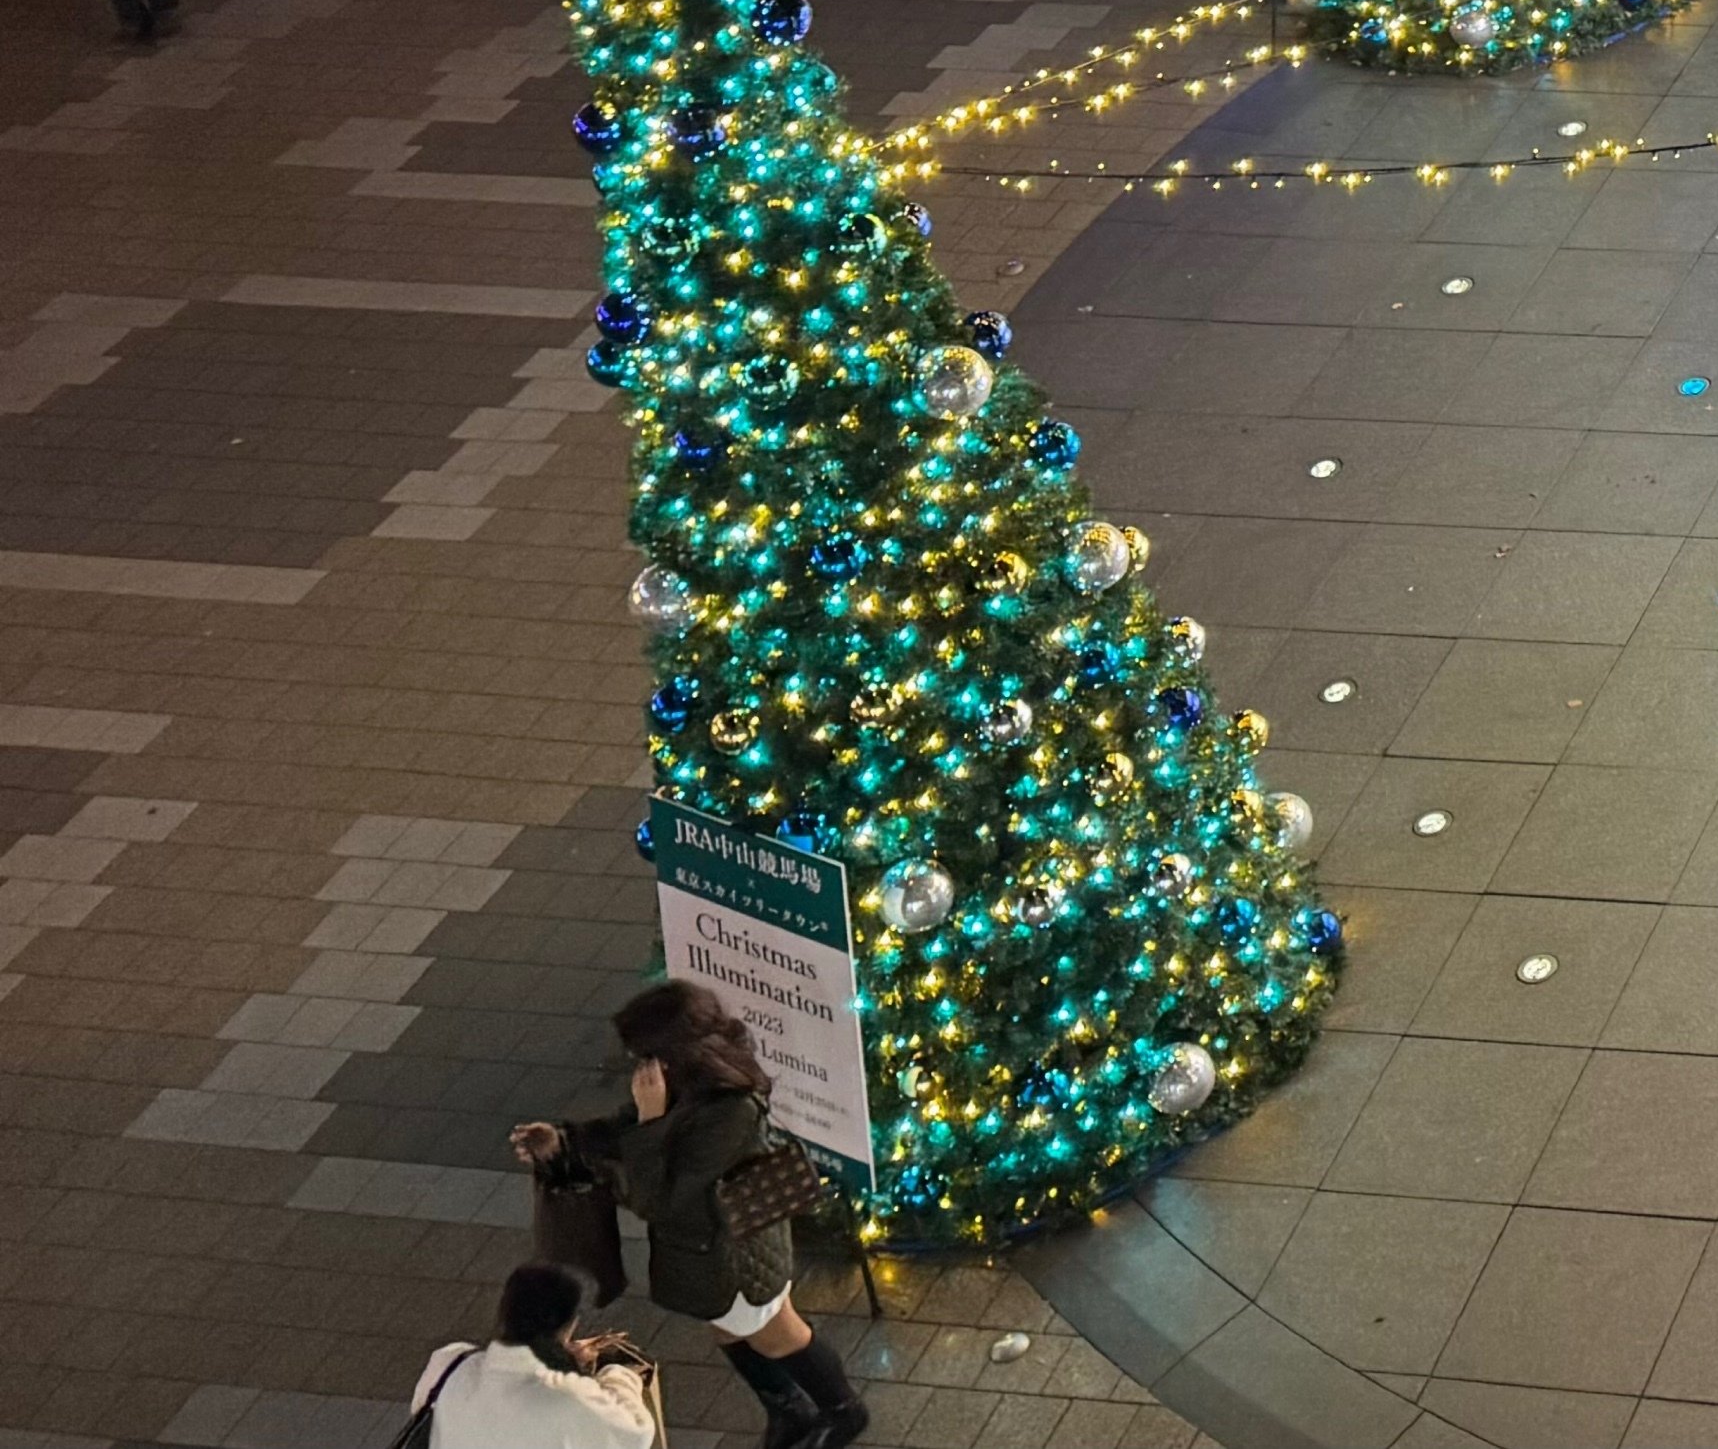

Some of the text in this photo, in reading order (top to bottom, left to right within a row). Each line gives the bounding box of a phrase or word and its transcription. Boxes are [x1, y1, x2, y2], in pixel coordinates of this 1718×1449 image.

[674, 817, 822, 894] JRA中山競馬場
[695, 912, 818, 980] Christmas
[687, 943, 834, 1023] Illumination
[741, 1005, 784, 1035] 2023
[760, 1038, 828, 1082] Lumina
